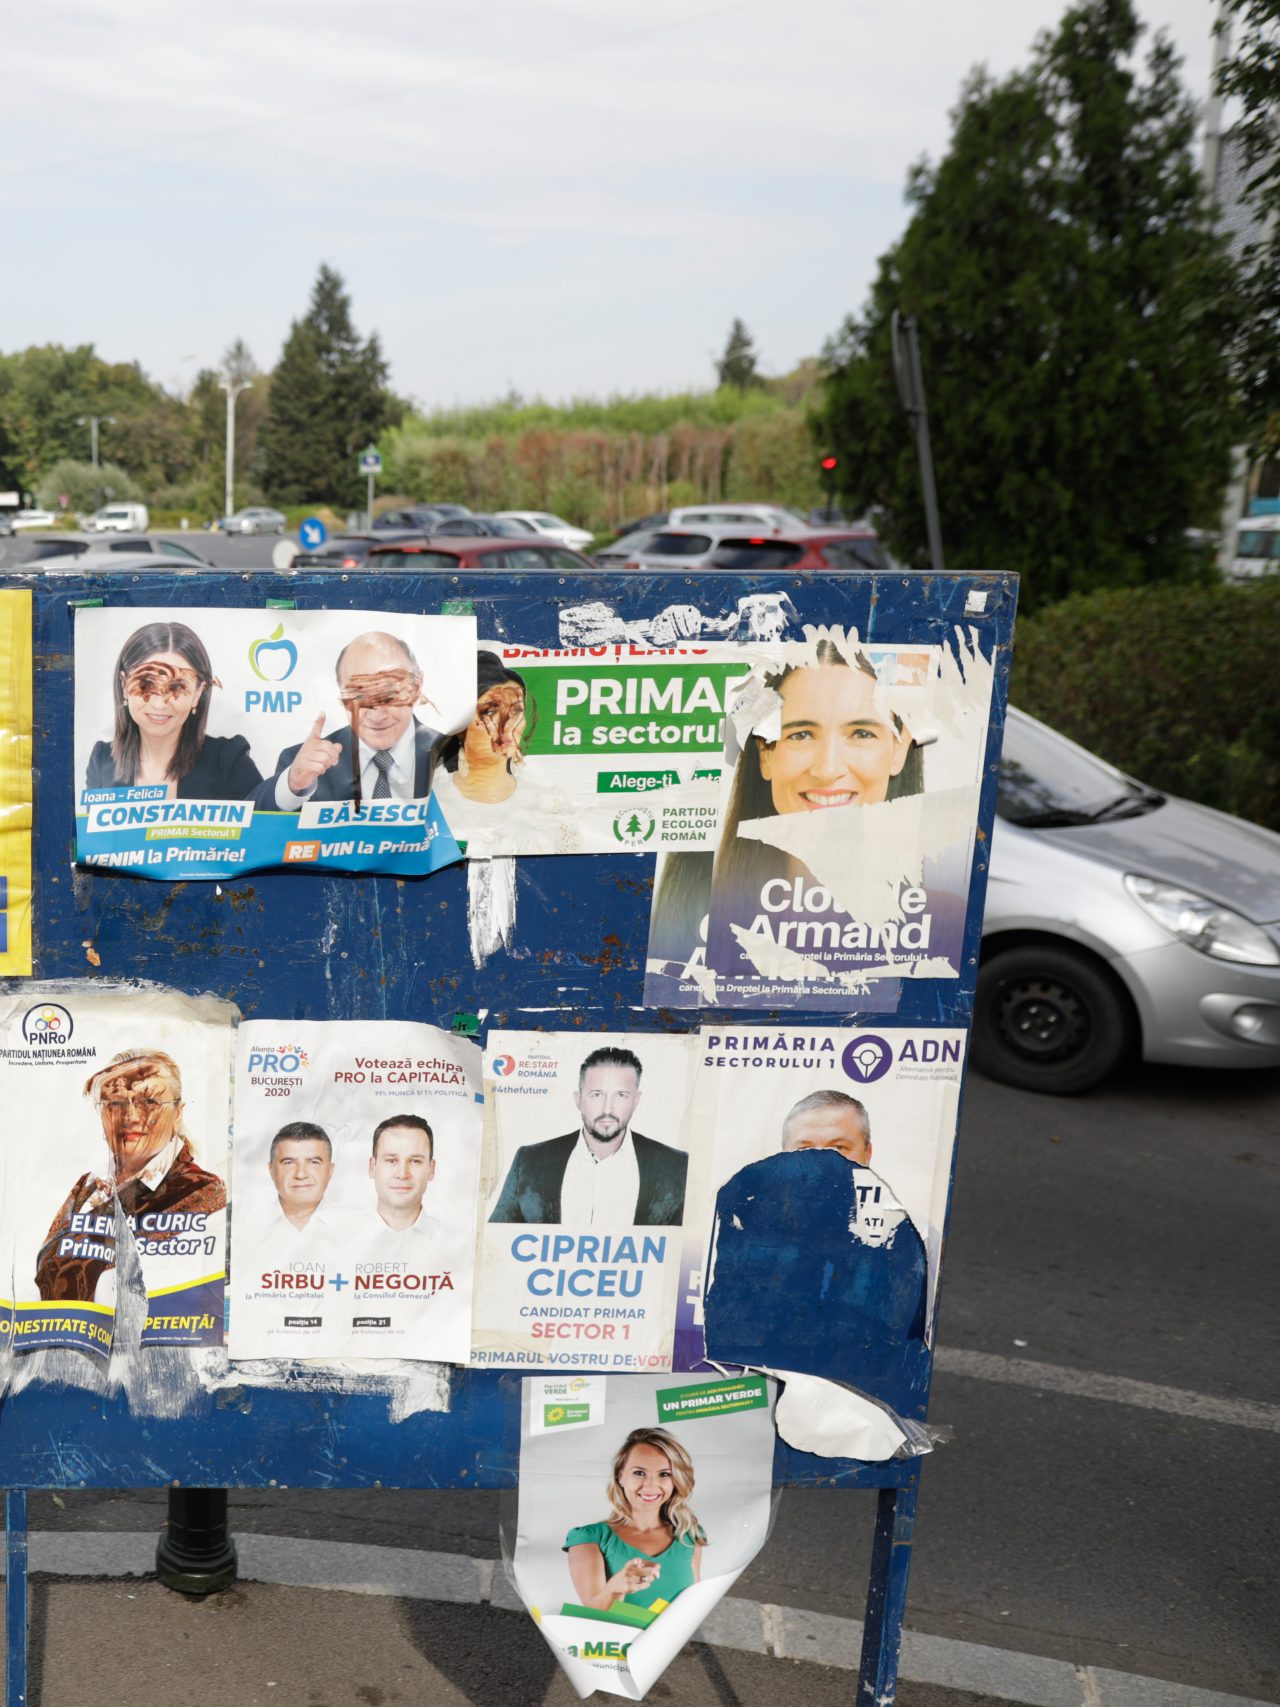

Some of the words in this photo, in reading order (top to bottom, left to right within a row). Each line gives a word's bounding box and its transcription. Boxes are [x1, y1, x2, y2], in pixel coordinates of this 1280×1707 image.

[245, 691, 302, 713] PMP
[553, 720, 581, 745] la
[84, 792, 115, 803] Ioana
[127, 787, 163, 800] Felicia
[96, 803, 246, 827] CONSTANTIN
[663, 808, 718, 816] PARTIDU
[150, 828, 188, 837] PRIMAR
[191, 828, 229, 837] Sectorul
[662, 820, 717, 829] ECOLOGI
[357, 841, 374, 854] la
[84, 850, 145, 867] VENIM
[148, 849, 162, 864] la
[166, 847, 246, 863] Primărie!
[30, 1032, 66, 1045] PNRo
[707, 1033, 836, 1052] PRIMĂRIA
[0, 1049, 31, 1059] PARTIDUL
[898, 1039, 961, 1063] ADN
[248, 1054, 299, 1073] PRO
[355, 1057, 412, 1069] Votează
[417, 1058, 463, 1073] echipa
[704, 1056, 822, 1069] SECTORULUI
[251, 1077, 303, 1088] BUCUREȘTI
[334, 1072, 366, 1083] PRO
[264, 1087, 291, 1097] 2020
[141, 1213, 208, 1232] CURIC
[136, 1237, 201, 1255] Sector
[511, 1234, 666, 1264] CIPRIAN
[289, 1262, 326, 1273] IOAN
[355, 1262, 409, 1273] ROBERT
[261, 1270, 325, 1290] SÎRBU
[355, 1272, 454, 1296] NEGOIȚĂ
[526, 1269, 643, 1298] CICEU
[520, 1306, 590, 1318] CANDIDAT
[594, 1308, 646, 1319] PRIMAR
[531, 1322, 615, 1340] SECTOR
[470, 1351, 544, 1364] PRIMARUL
[549, 1353, 608, 1365] VOSTRU
[663, 1402, 680, 1412] UN
[680, 1395, 723, 1409] PRIMAR
[724, 1388, 762, 1402] VERDE
